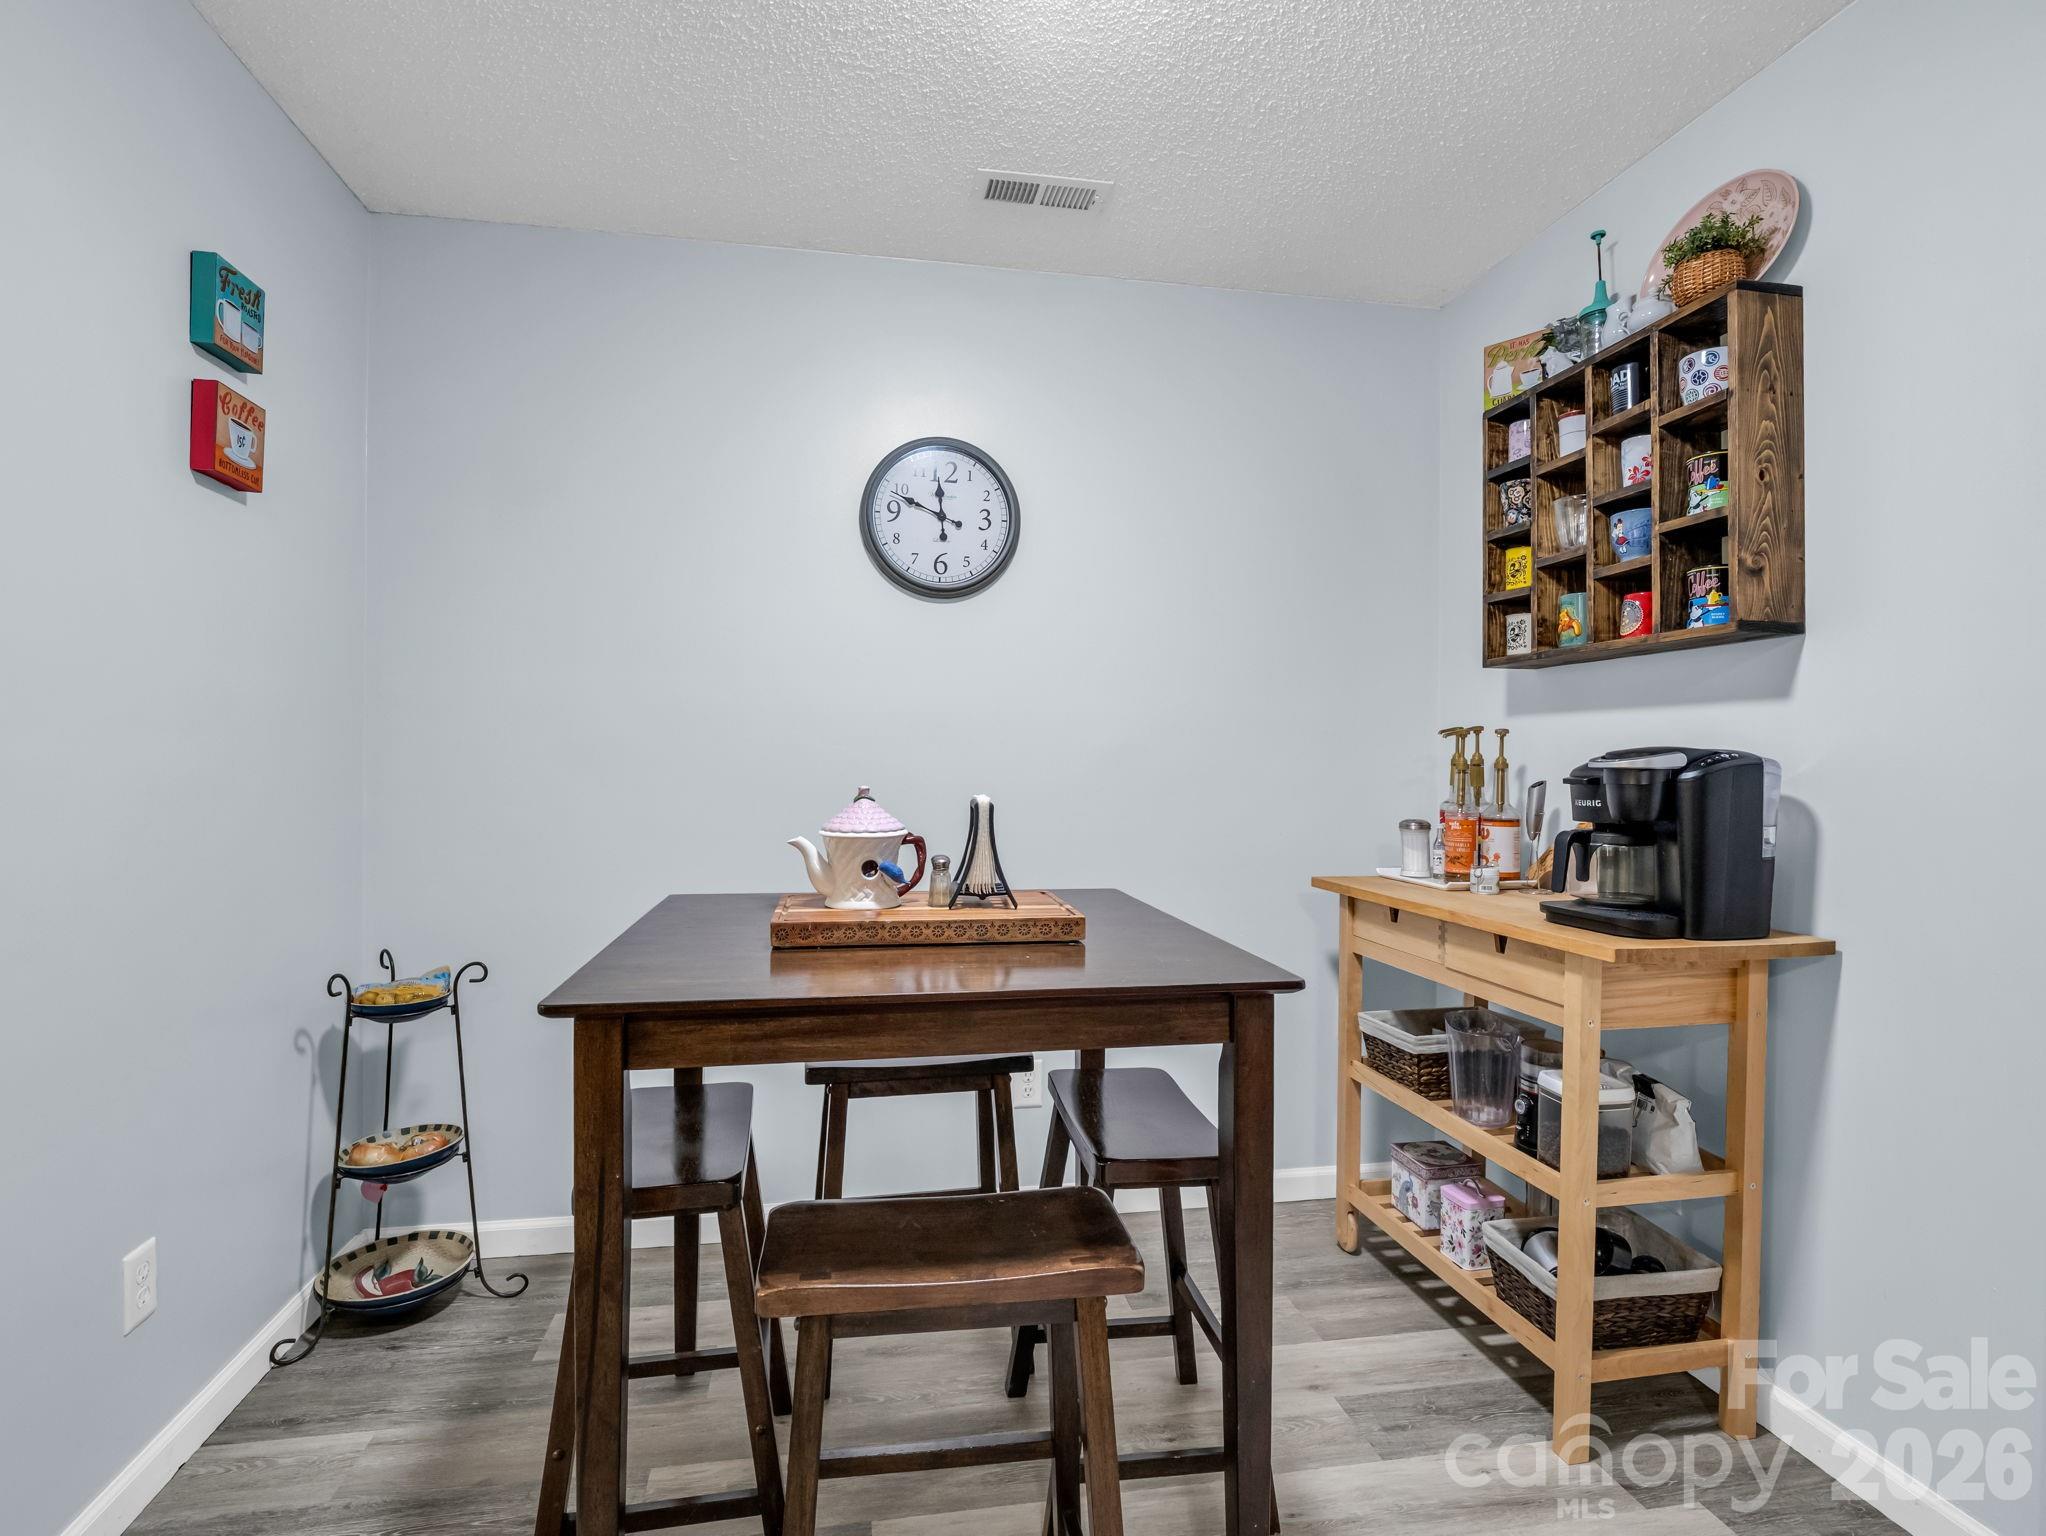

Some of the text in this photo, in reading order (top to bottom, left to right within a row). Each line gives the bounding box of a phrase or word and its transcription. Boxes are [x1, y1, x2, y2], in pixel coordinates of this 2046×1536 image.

[219, 266, 262, 311] Fresh
[1610, 369, 1628, 387] AD
[219, 391, 264, 431] Coffee
[218, 457, 250, 481] BOTTOMLESS
[913, 467, 927, 478] 11
[930, 461, 958, 483] 12
[967, 470, 973, 482] 1
[1688, 457, 1720, 485] Coffee
[894, 482, 909, 495] 10
[983, 490, 991, 502] 2
[886, 499, 902, 523] 9
[978, 508, 992, 531] 3
[892, 532, 901, 545] 8
[980, 539, 989, 551] 4
[911, 552, 919, 565] 7
[933, 552, 948, 575] 6
[962, 556, 971, 568] 5
[1688, 570, 1721, 599] Coffee
[1574, 799, 1603, 807] KEURIG
